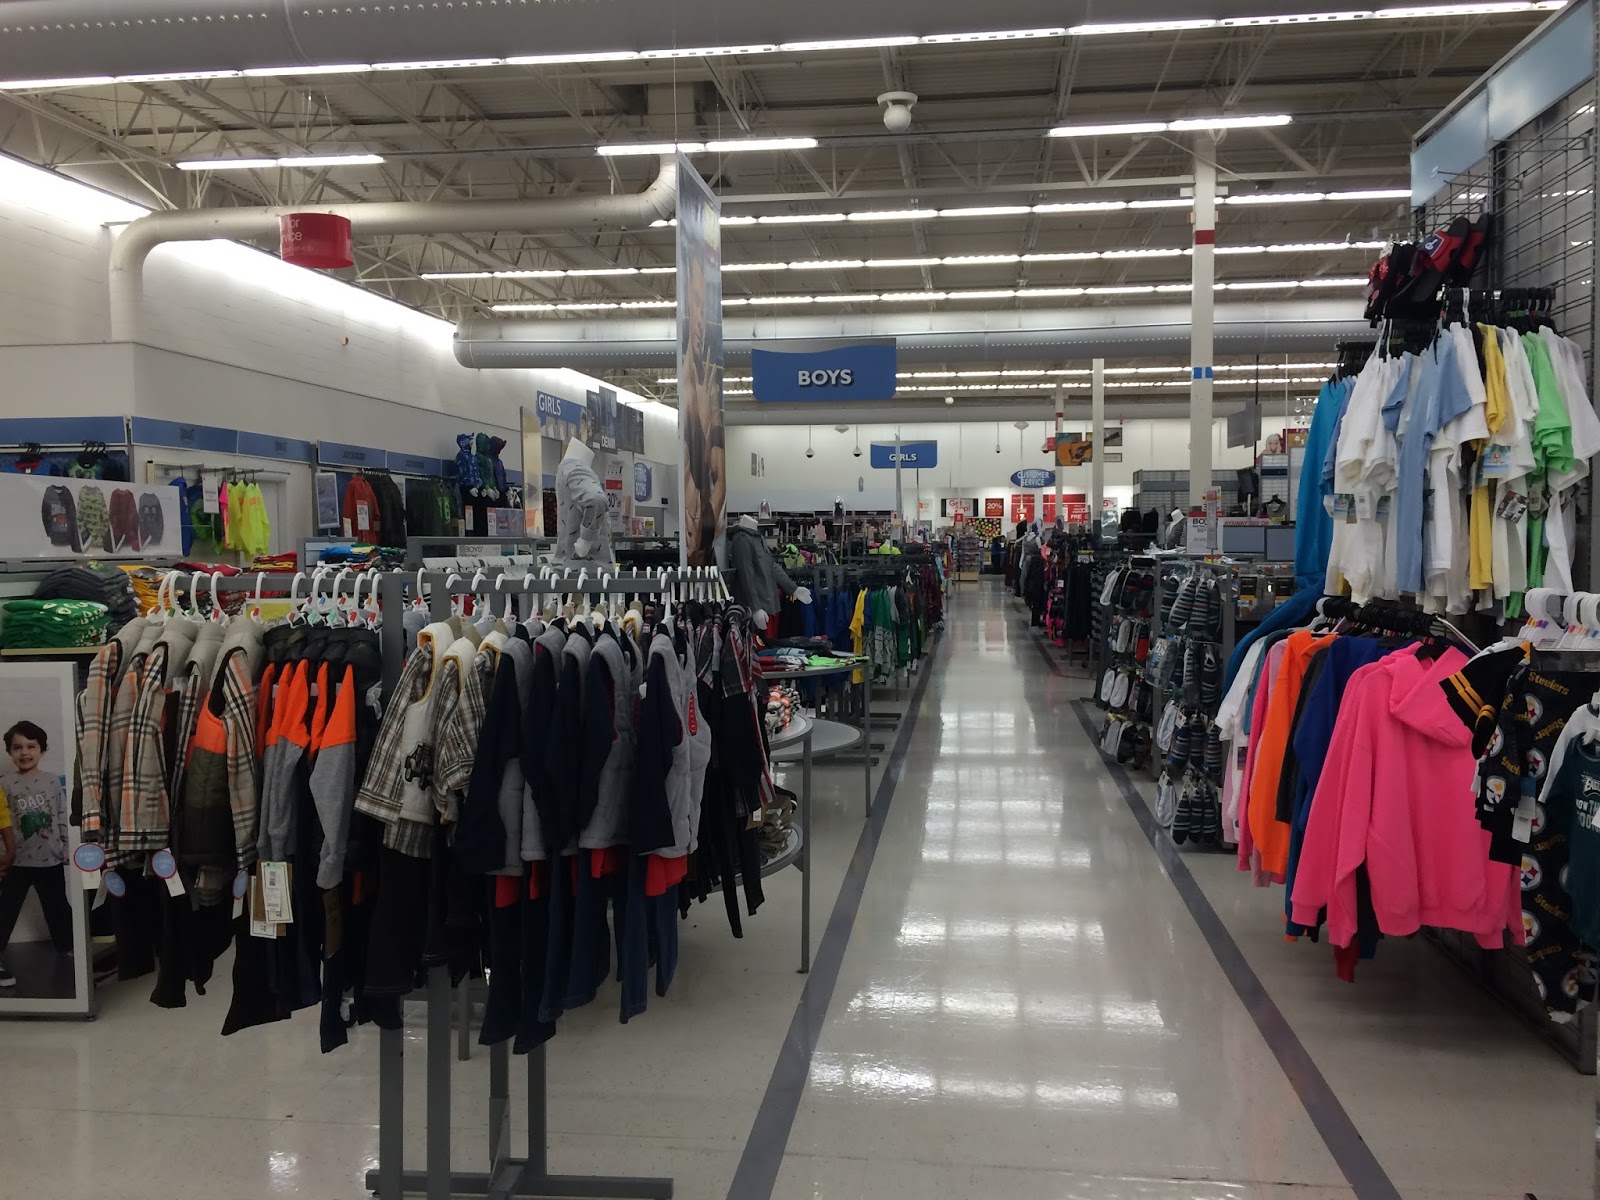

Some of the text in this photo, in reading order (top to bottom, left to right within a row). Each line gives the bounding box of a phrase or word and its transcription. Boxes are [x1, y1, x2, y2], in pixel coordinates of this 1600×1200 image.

[798, 369, 852, 386] BOYS
[538, 394, 561, 416] GIRLS
[889, 453, 917, 461] GRLS
[1017, 471, 1050, 479] CUSTOMER
[1528, 670, 1570, 696] Steelers
[17, 794, 45, 810] DAD
